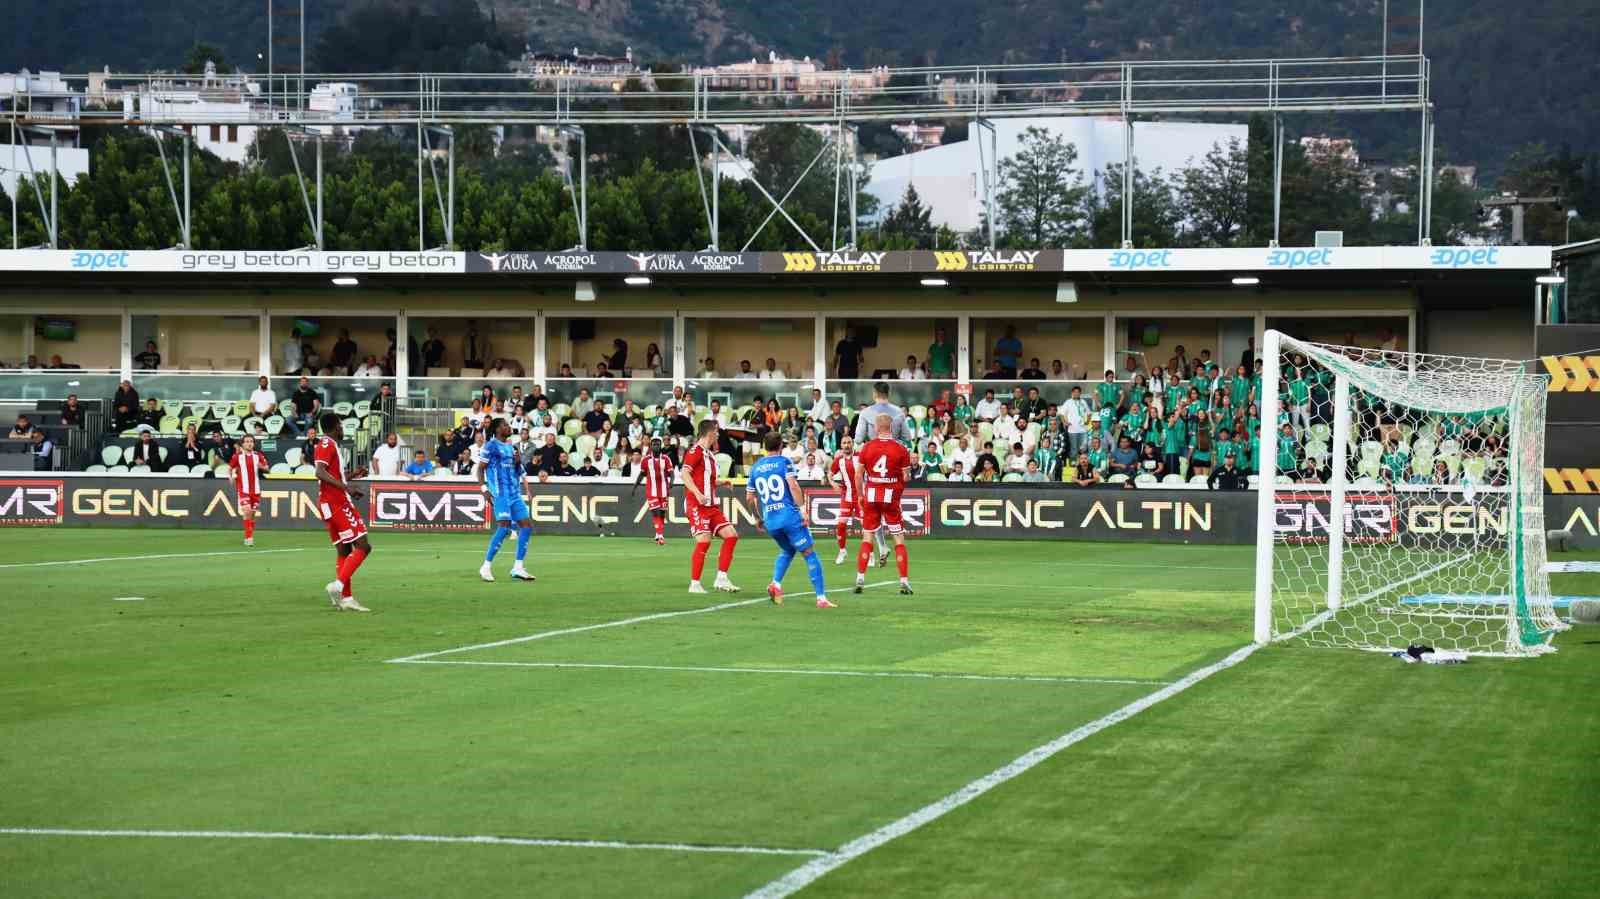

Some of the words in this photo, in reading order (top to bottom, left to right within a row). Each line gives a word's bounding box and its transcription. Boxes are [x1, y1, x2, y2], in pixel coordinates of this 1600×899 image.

[73, 252, 129, 269] opet
[182, 253, 236, 269] grey
[244, 252, 311, 266] beton
[327, 254, 381, 270] grey
[389, 253, 456, 267] beton
[502, 257, 538, 270] AURA
[544, 254, 597, 265] ACROPOL
[649, 257, 685, 270] AURA
[691, 254, 745, 265] ACROPOL
[816, 252, 887, 265] TALAY
[968, 250, 1040, 263] TALAY
[1108, 249, 1172, 269] opet
[1266, 248, 1333, 268] opet
[1430, 246, 1499, 268] opet
[873, 455, 888, 478] 4
[755, 474, 785, 504] 99
[377, 491, 485, 522] GMR
[811, 498, 925, 527] GR
[1080, 500, 1212, 531] ALTIN
